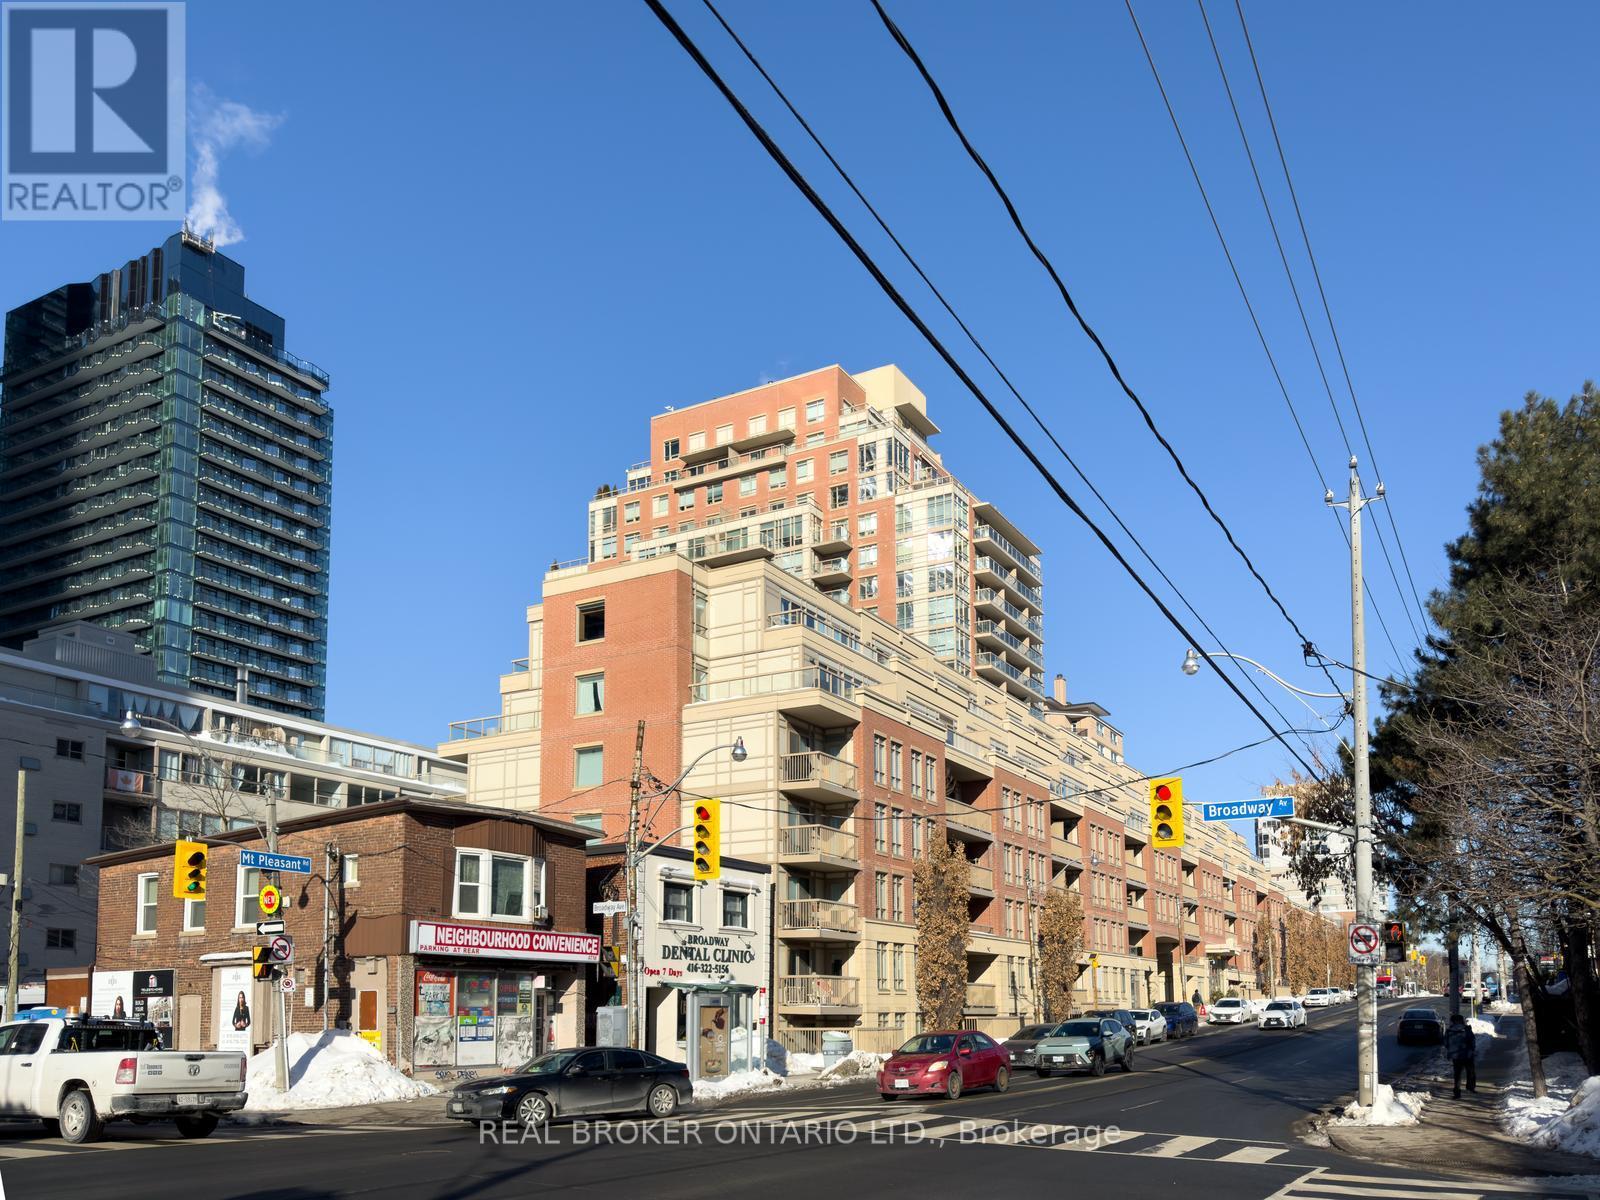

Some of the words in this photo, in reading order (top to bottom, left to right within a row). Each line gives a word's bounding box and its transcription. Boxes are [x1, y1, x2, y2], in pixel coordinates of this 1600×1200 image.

[1208, 802, 1274, 817] Broadway
[242, 852, 255, 865] Mt
[258, 854, 301, 870] Pleasant
[302, 859, 309, 867] Rd
[435, 926, 532, 949] NEIGHBOURHOOD
[532, 934, 598, 954] CONVENIENCE
[687, 934, 730, 948] BROADWAY
[419, 944, 449, 953] PARKING
[463, 947, 481, 955] REAR
[661, 945, 711, 962] DENTAL
[713, 948, 752, 964] CLINIC
[644, 966, 661, 976] Open
[662, 967, 667, 976] 7
[668, 967, 683, 978] Days
[686, 963, 730, 974] 416-322-5156
